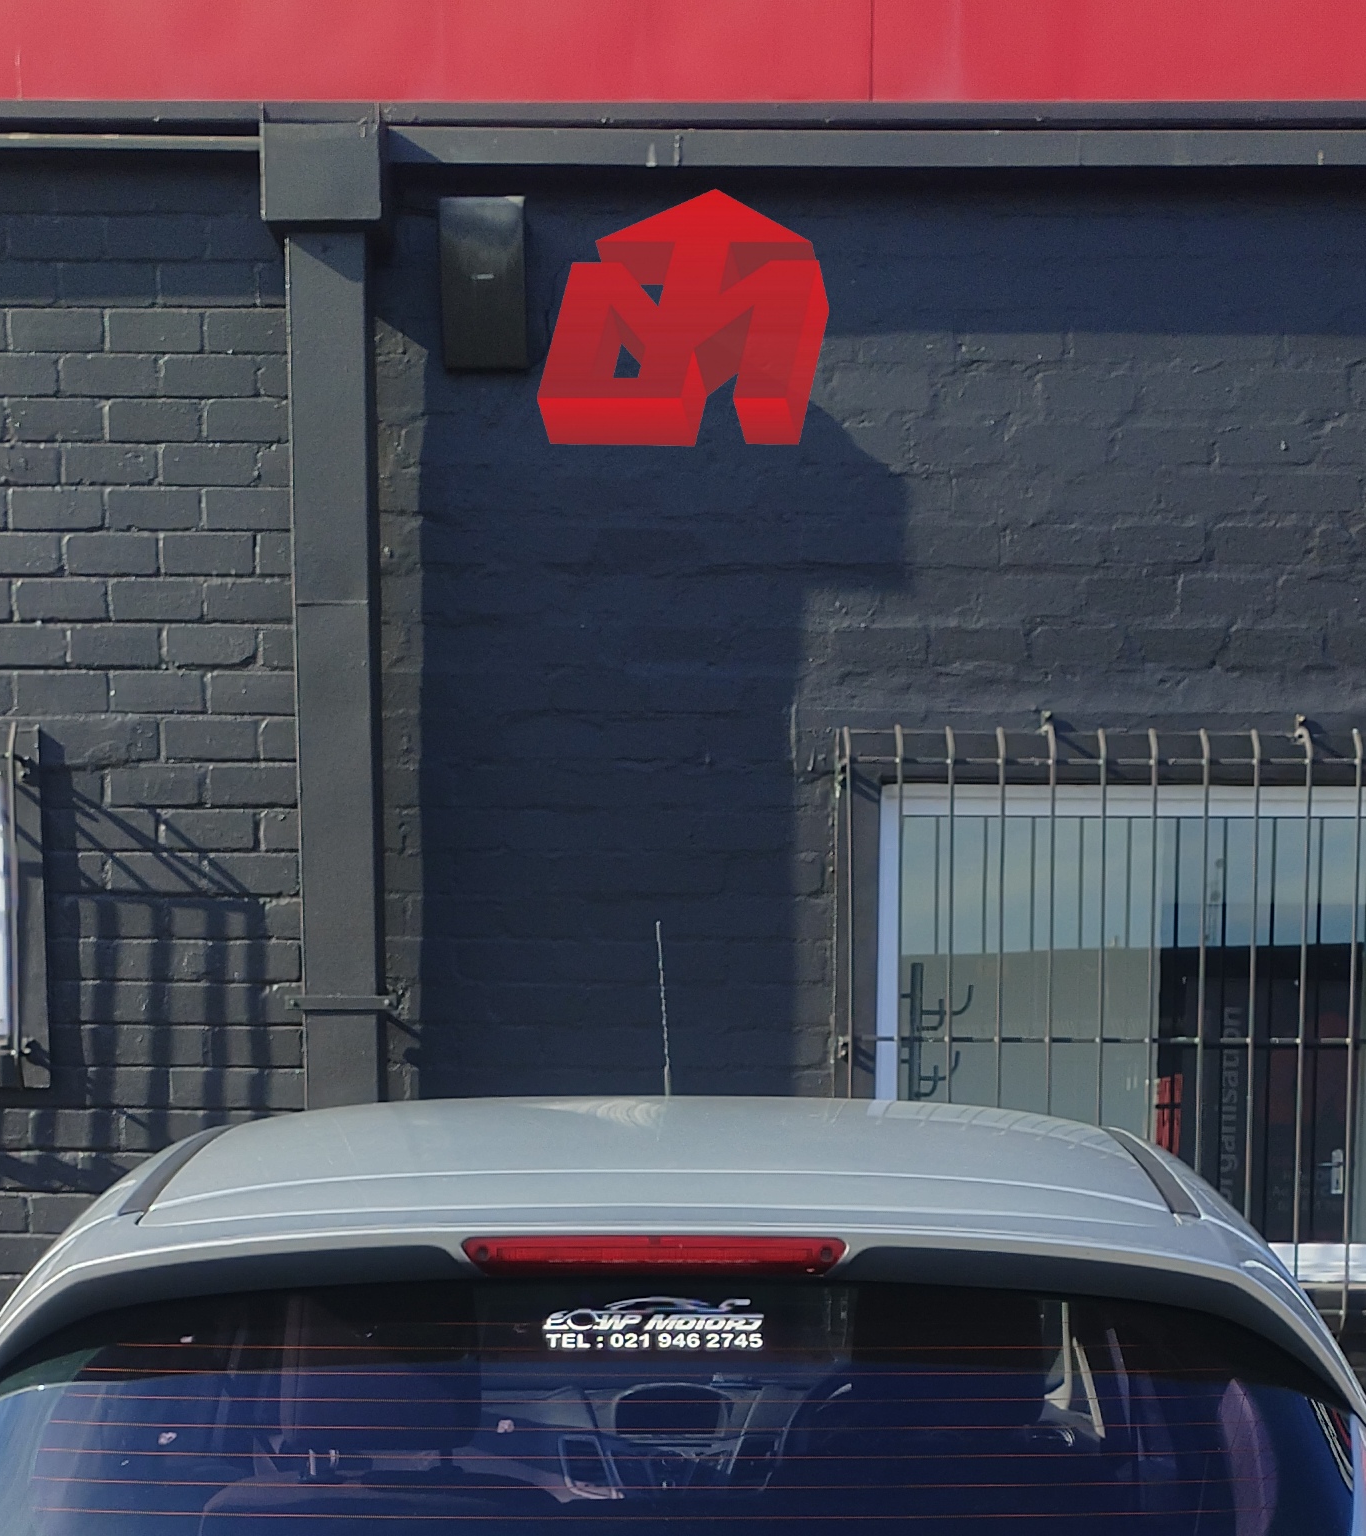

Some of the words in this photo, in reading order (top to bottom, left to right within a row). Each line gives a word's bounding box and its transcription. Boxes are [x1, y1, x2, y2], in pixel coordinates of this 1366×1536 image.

[545, 1332, 591, 1349] TEL
[609, 1332, 650, 1349] 021
[657, 1332, 701, 1348] 946
[705, 1333, 764, 1349] 2745
